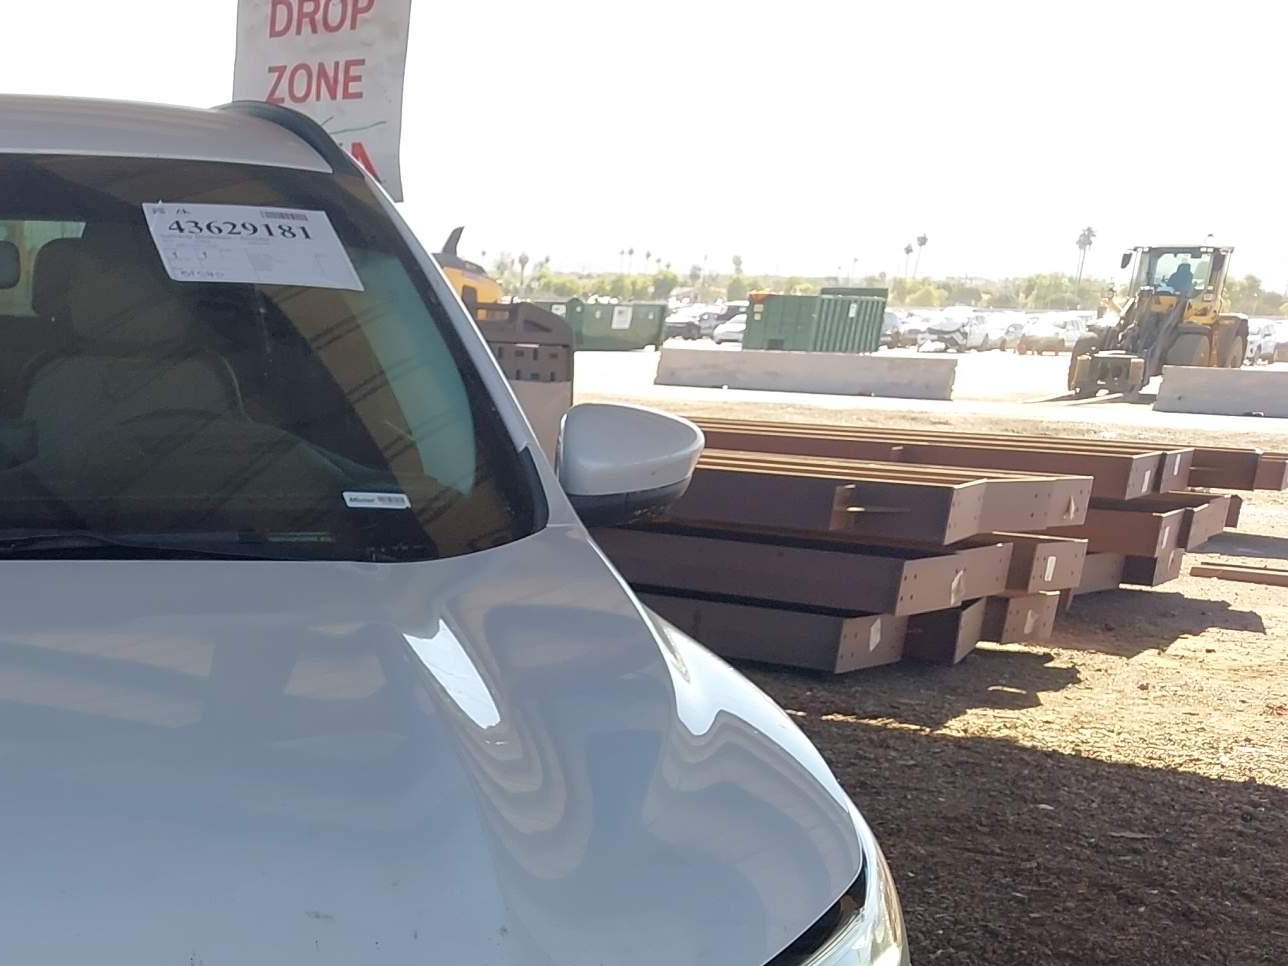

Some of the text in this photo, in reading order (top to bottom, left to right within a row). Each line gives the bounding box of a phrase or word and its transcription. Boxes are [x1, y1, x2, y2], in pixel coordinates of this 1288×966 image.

[268, 0, 376, 39] DROP
[265, 58, 366, 105] ZONE
[168, 218, 313, 241] 43629181
